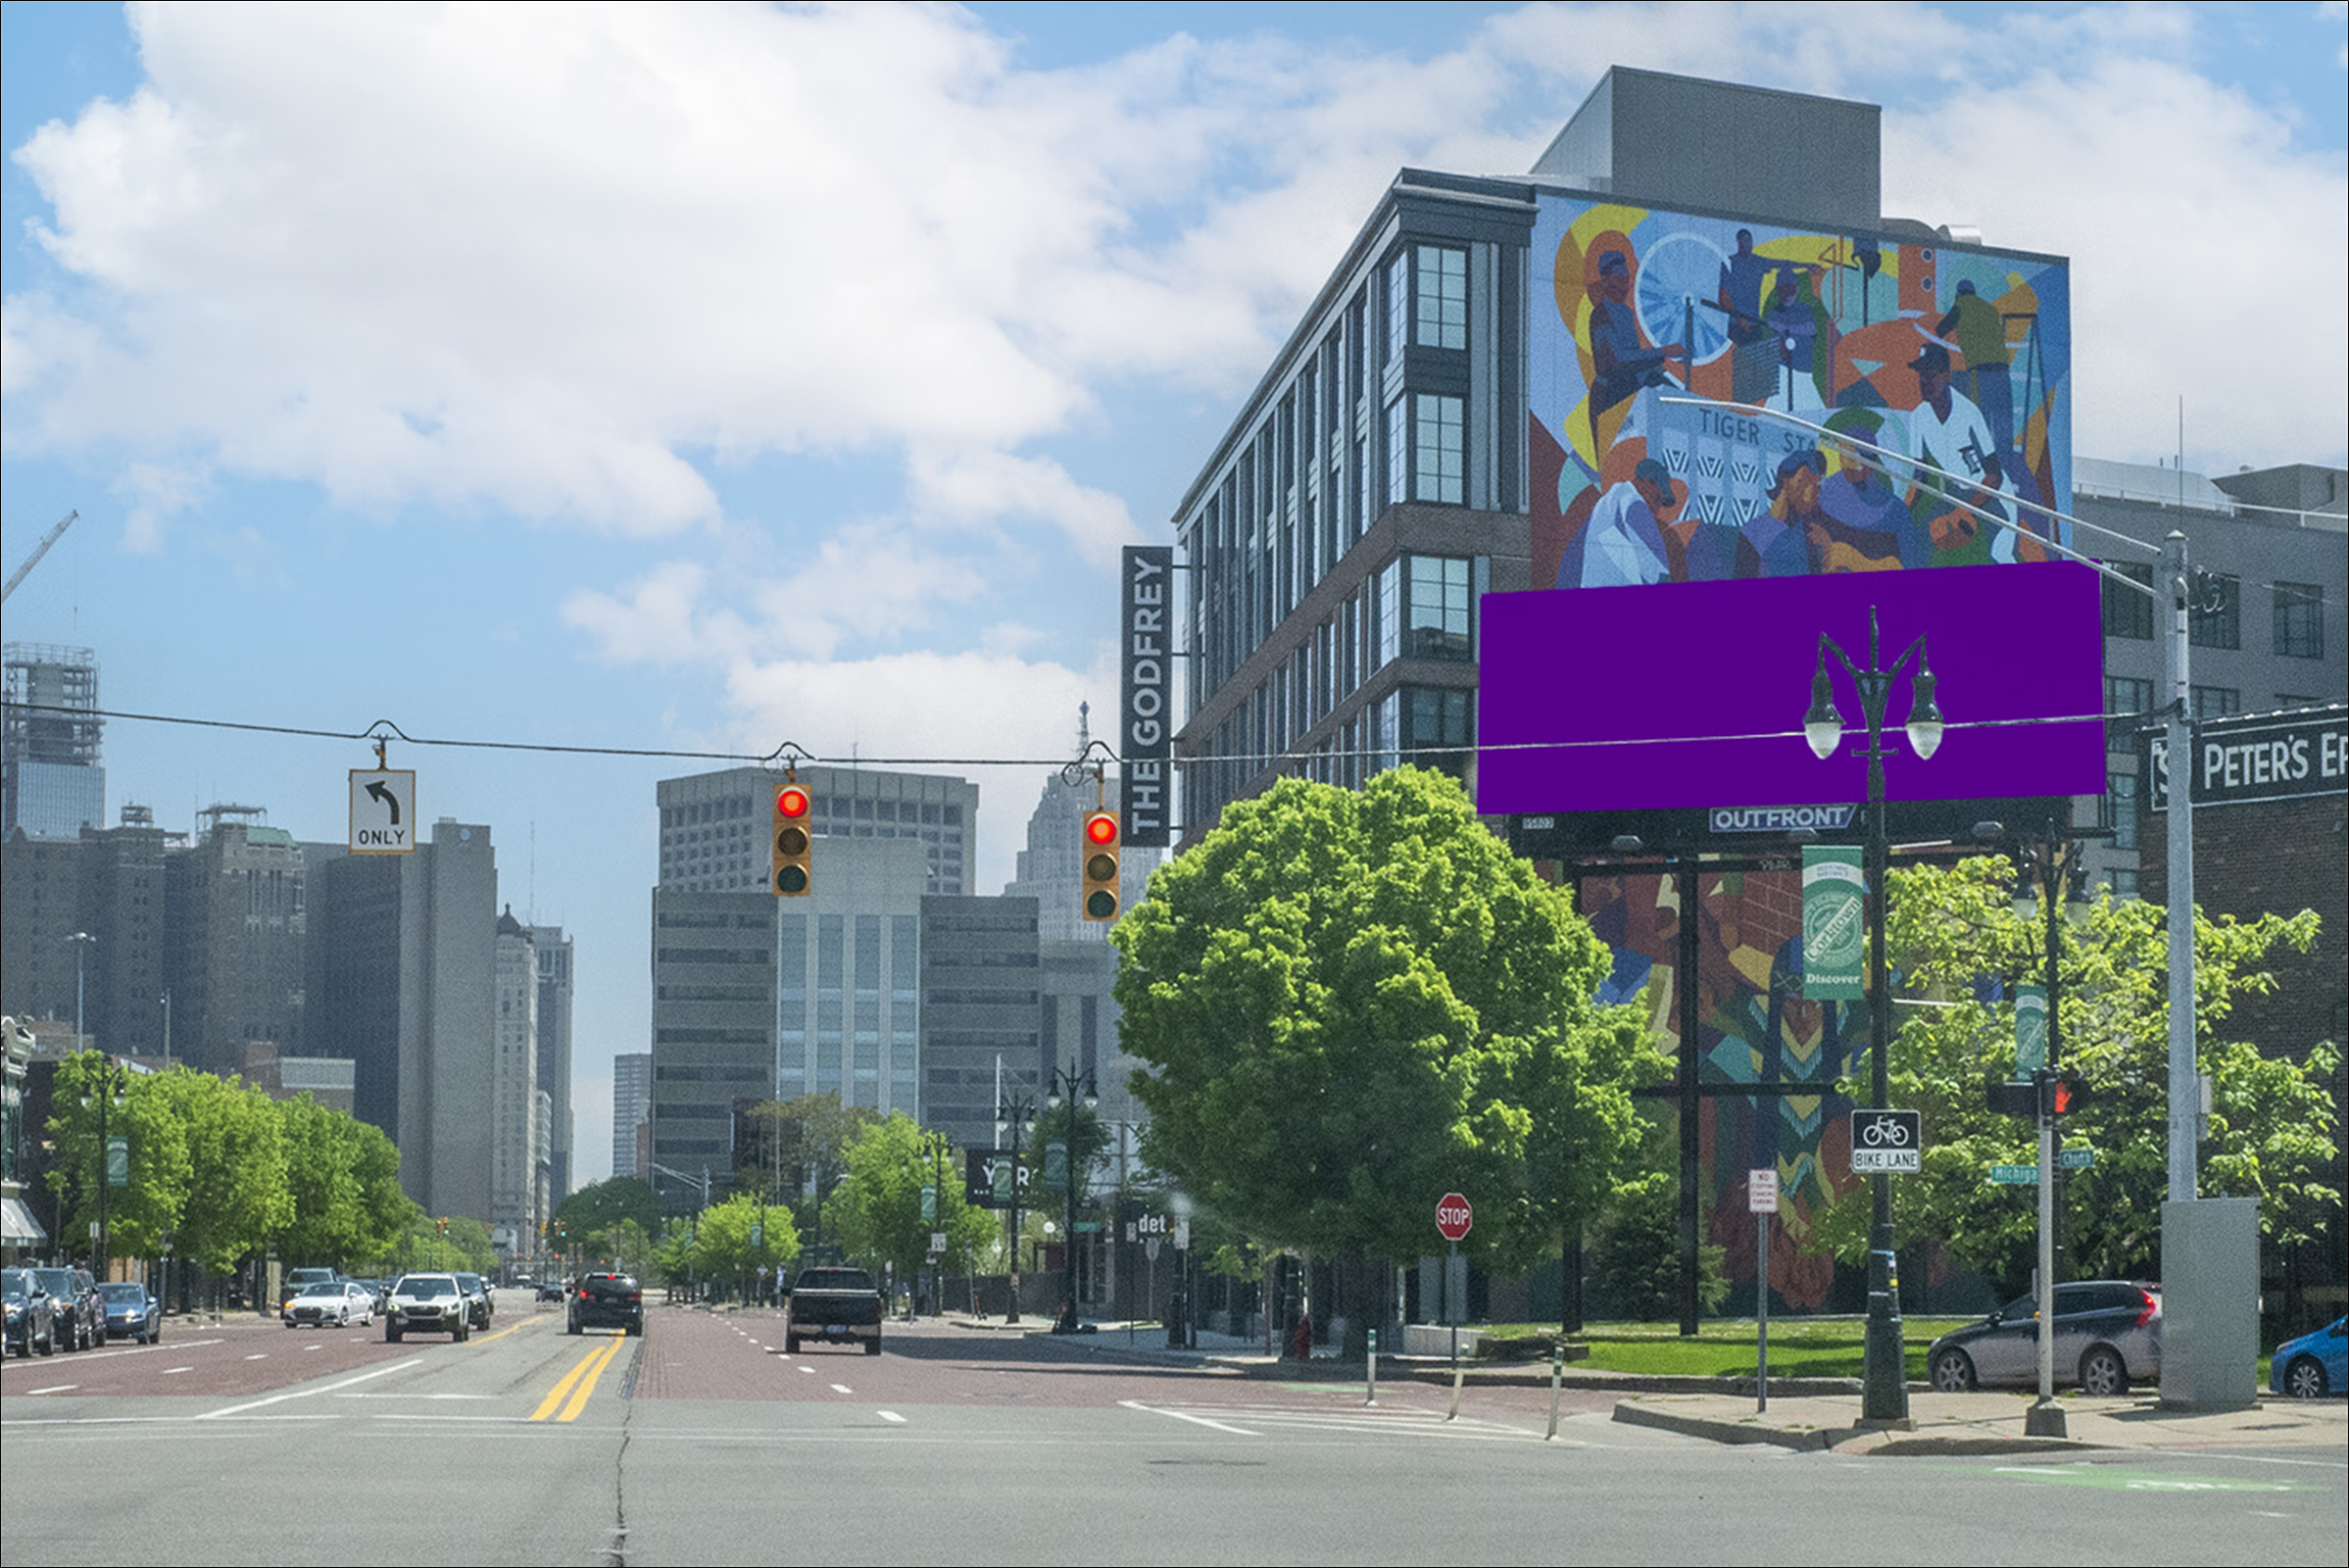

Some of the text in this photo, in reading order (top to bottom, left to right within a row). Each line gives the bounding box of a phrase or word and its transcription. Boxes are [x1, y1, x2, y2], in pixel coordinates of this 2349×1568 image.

[1699, 408, 1760, 445] TIGER
[1132, 556, 1163, 835] THE GODFREY
[2205, 734, 2309, 790] PETER'S
[1715, 807, 1848, 829] OUTFRONT
[359, 829, 405, 845] ONLY
[1807, 900, 1861, 959] Corktown
[1806, 973, 1861, 985] Discover
[1855, 1152, 1917, 1167] BIKE LANE
[1995, 1165, 2039, 1184] Michiga
[1139, 1214, 1167, 1233] det
[1439, 1207, 1469, 1225] STOP
